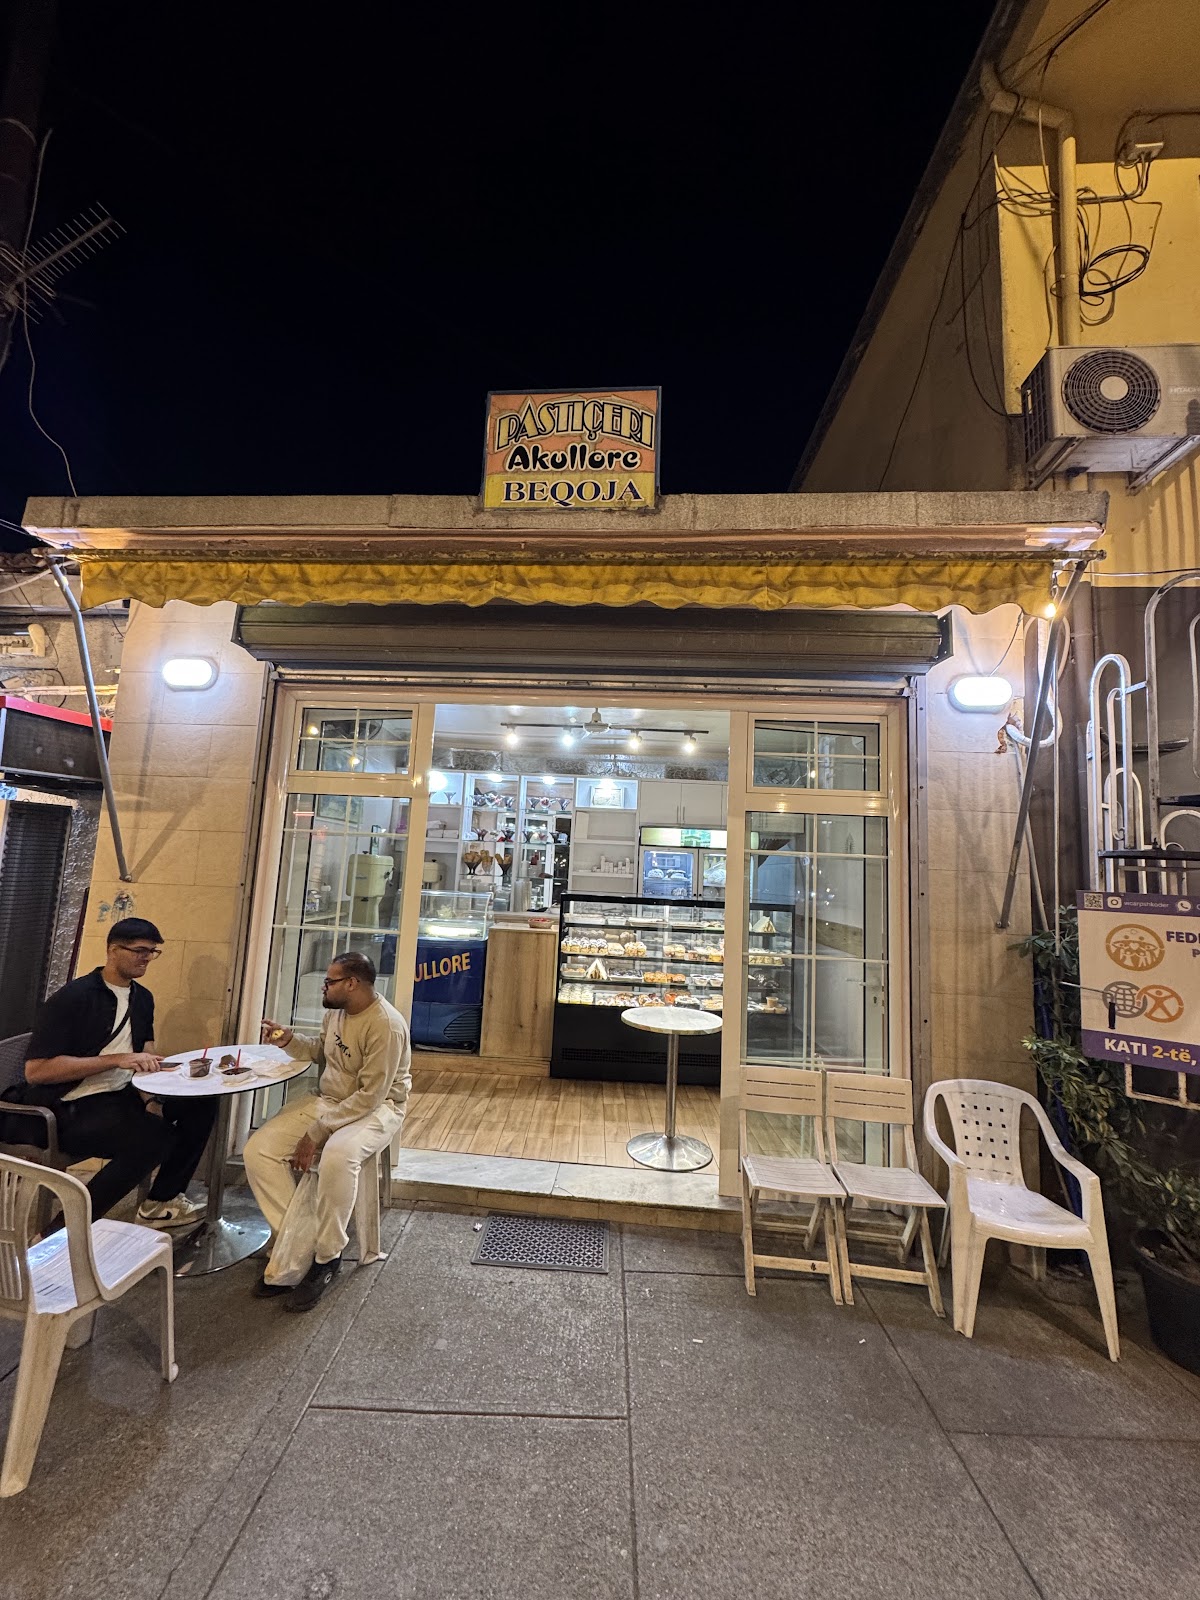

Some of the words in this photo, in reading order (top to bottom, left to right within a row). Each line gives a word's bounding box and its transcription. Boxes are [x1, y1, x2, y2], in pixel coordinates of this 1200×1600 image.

[496, 399, 655, 450] PASTIÇERI
[507, 445, 640, 470] Akullore
[503, 480, 642, 507] BEQOJA
[1104, 1038, 1147, 1056] KATI
[1152, 1044, 1197, 1066] 2-të,
